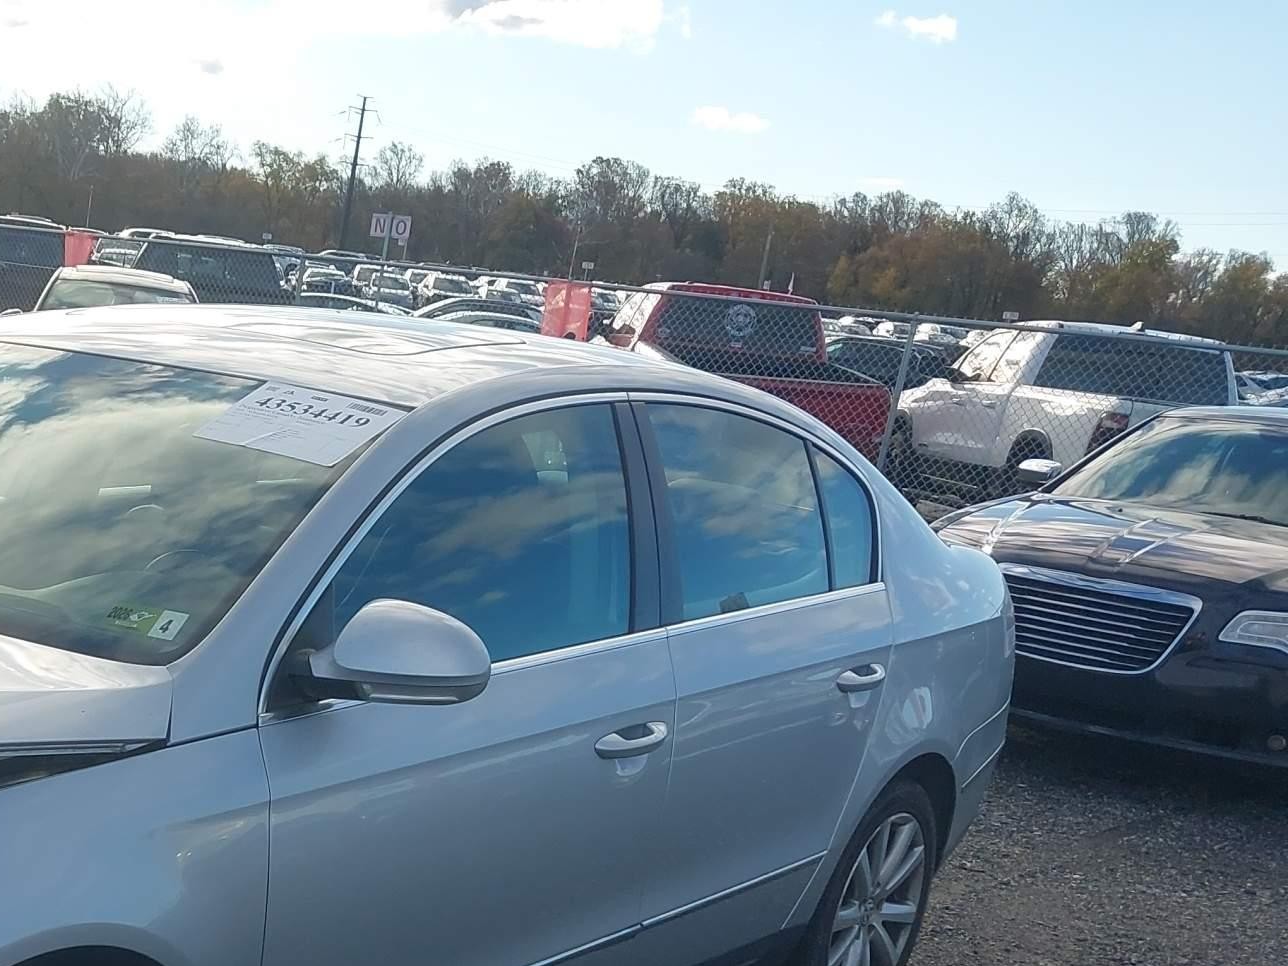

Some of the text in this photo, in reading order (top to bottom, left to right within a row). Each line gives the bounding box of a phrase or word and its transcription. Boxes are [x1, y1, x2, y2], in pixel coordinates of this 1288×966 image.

[374, 217, 386, 234] N
[255, 396, 371, 428] 43534419
[158, 619, 174, 634] 4
